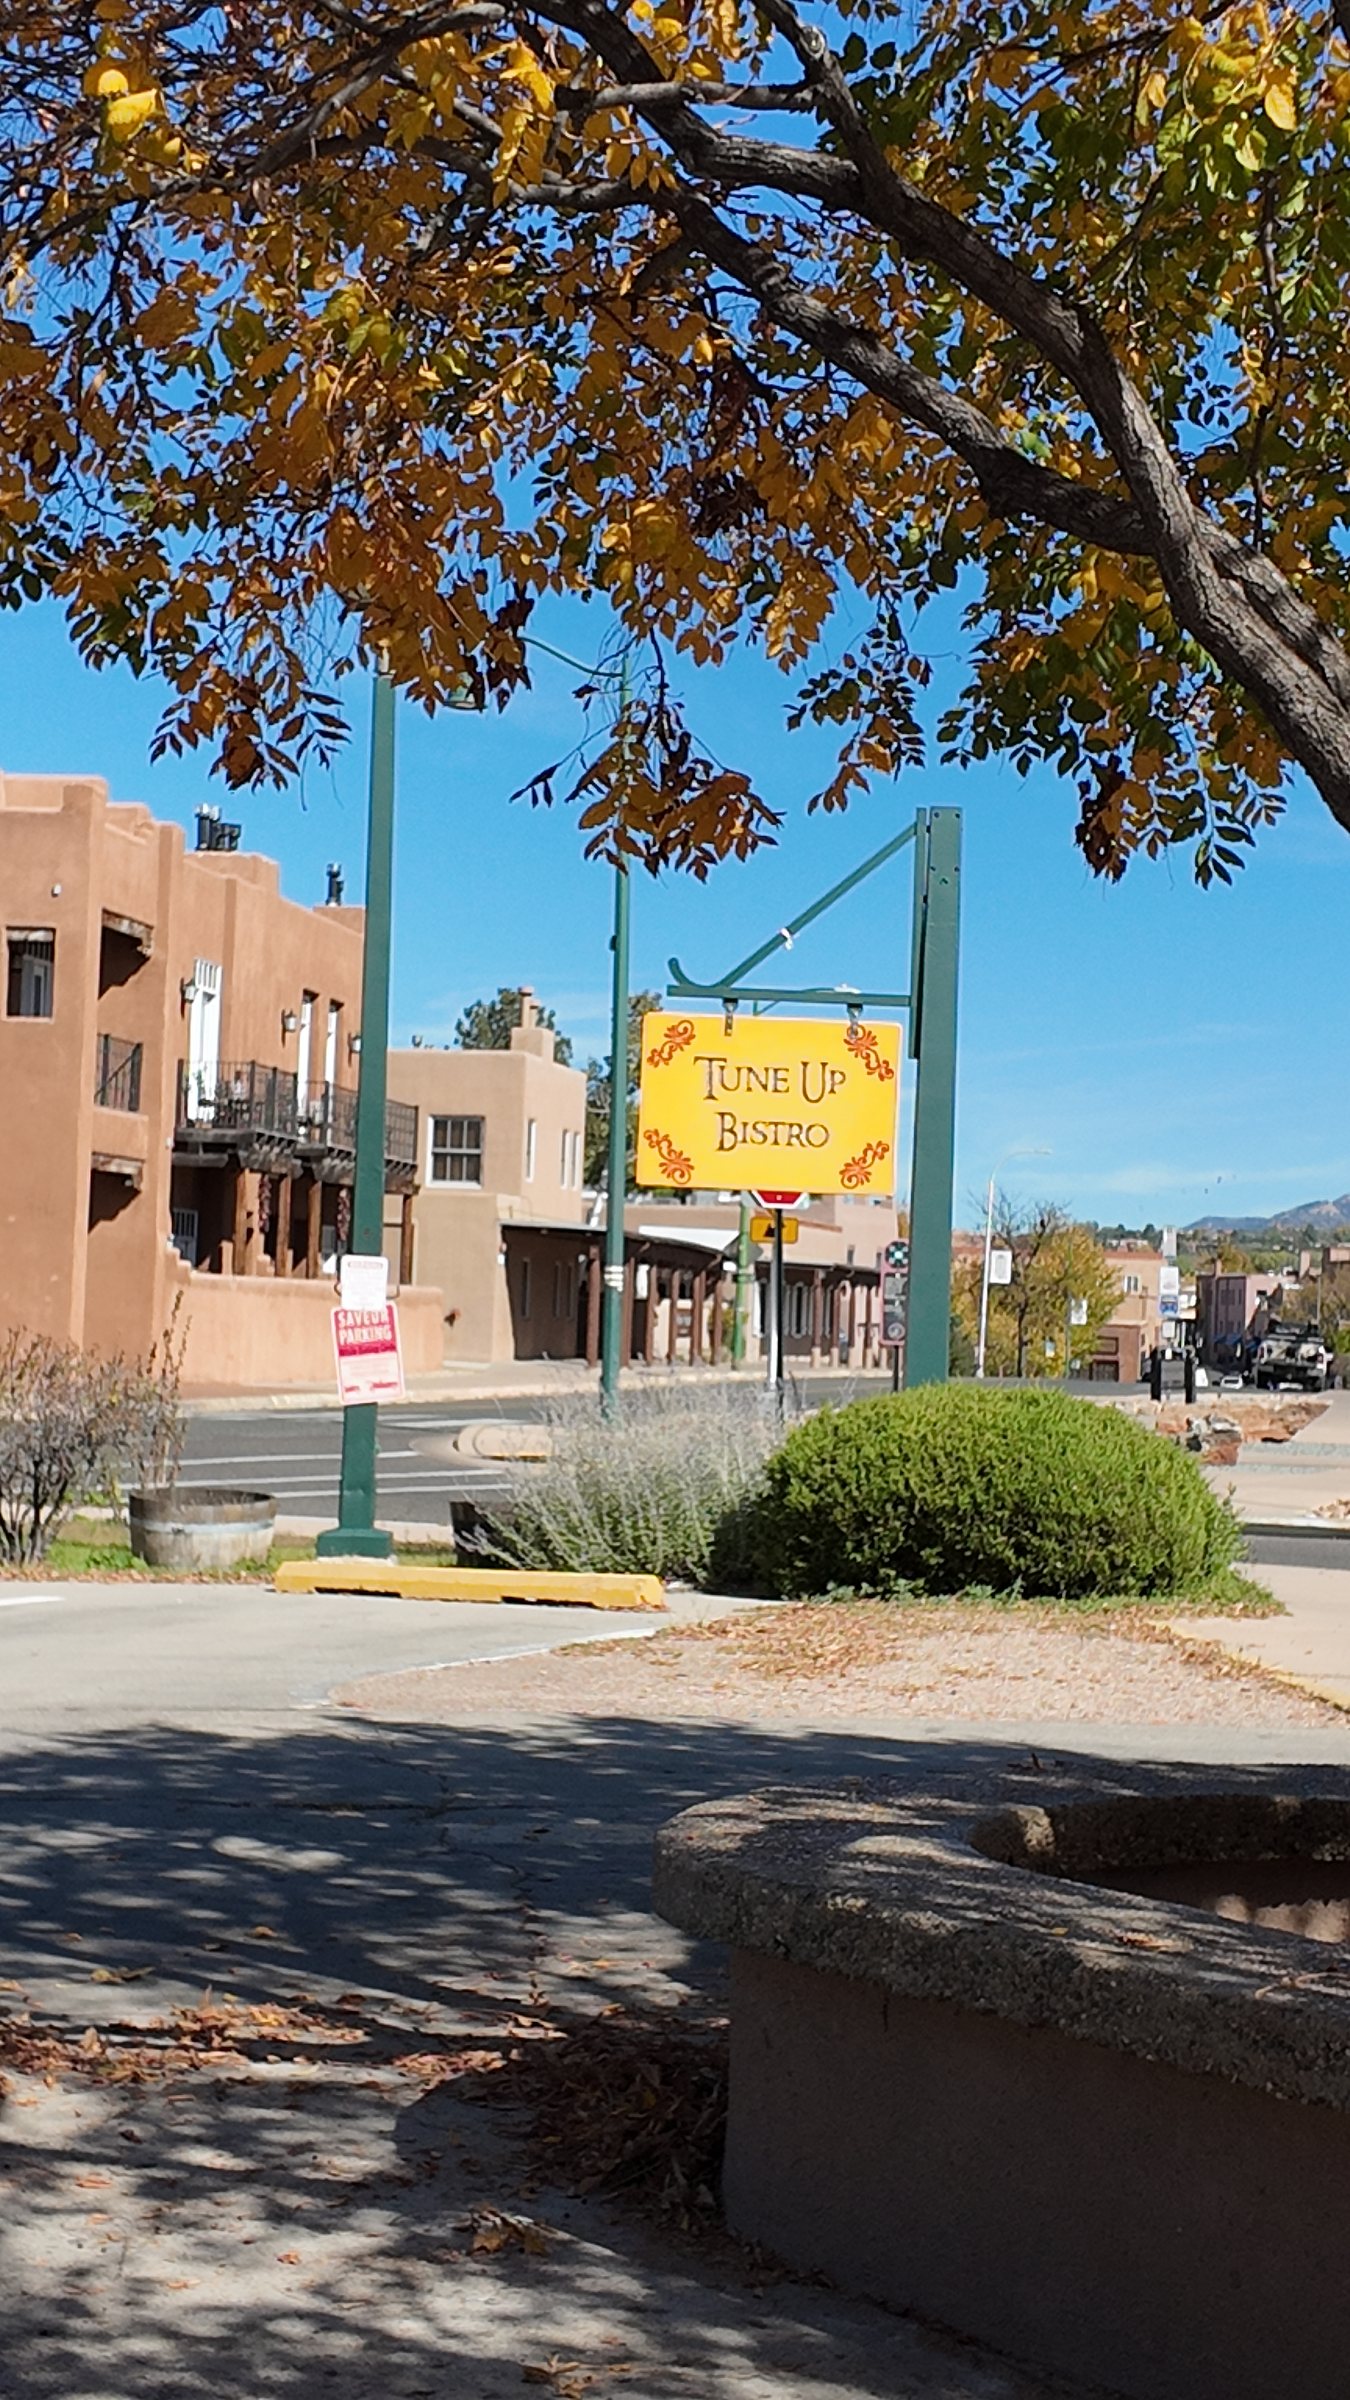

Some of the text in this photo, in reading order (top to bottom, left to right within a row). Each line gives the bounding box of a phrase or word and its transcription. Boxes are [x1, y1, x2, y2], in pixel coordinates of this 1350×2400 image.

[693, 1055, 846, 1104] TUNE UP
[714, 1111, 830, 1152] BISTRO
[338, 1325, 393, 1345] PARKING
